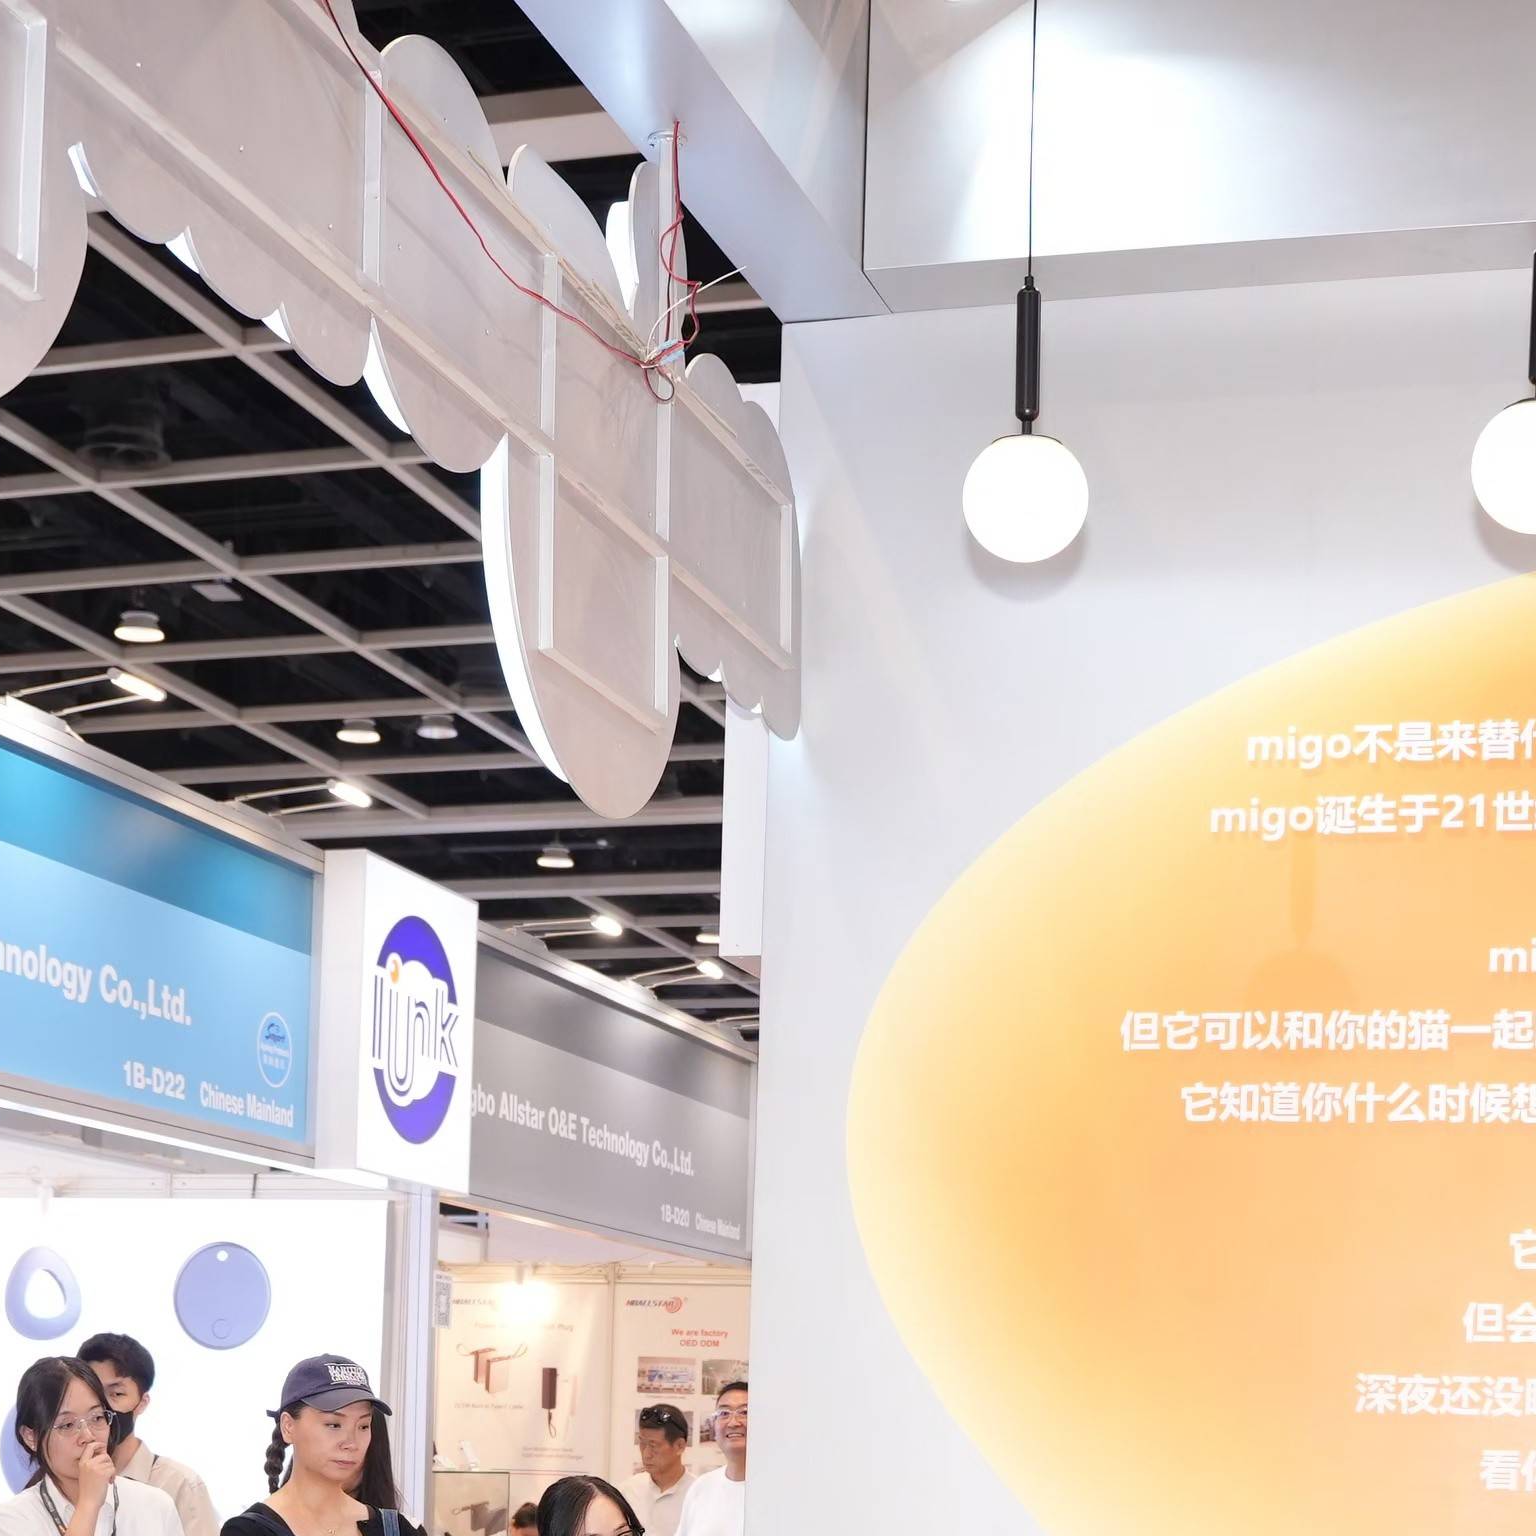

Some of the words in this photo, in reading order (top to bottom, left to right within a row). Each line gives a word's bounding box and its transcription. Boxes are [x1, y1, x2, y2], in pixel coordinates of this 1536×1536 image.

[99, 964, 192, 1026] Co.,Ltd.
[122, 1060, 186, 1101] 1B-D22
[200, 1081, 245, 1117] Chinese
[247, 1093, 294, 1129] Mainland
[499, 1091, 545, 1130] Allstar
[548, 1106, 577, 1141] O&E
[580, 1116, 650, 1168] Technology
[652, 1140, 694, 1177] Co.,Ltd.
[660, 1204, 690, 1228] 1B-D20
[695, 1212, 716, 1234] Chinese
[717, 1218, 741, 1240] Mainland
[671, 1328, 684, 1336] We
[700, 1328, 729, 1339] factory
